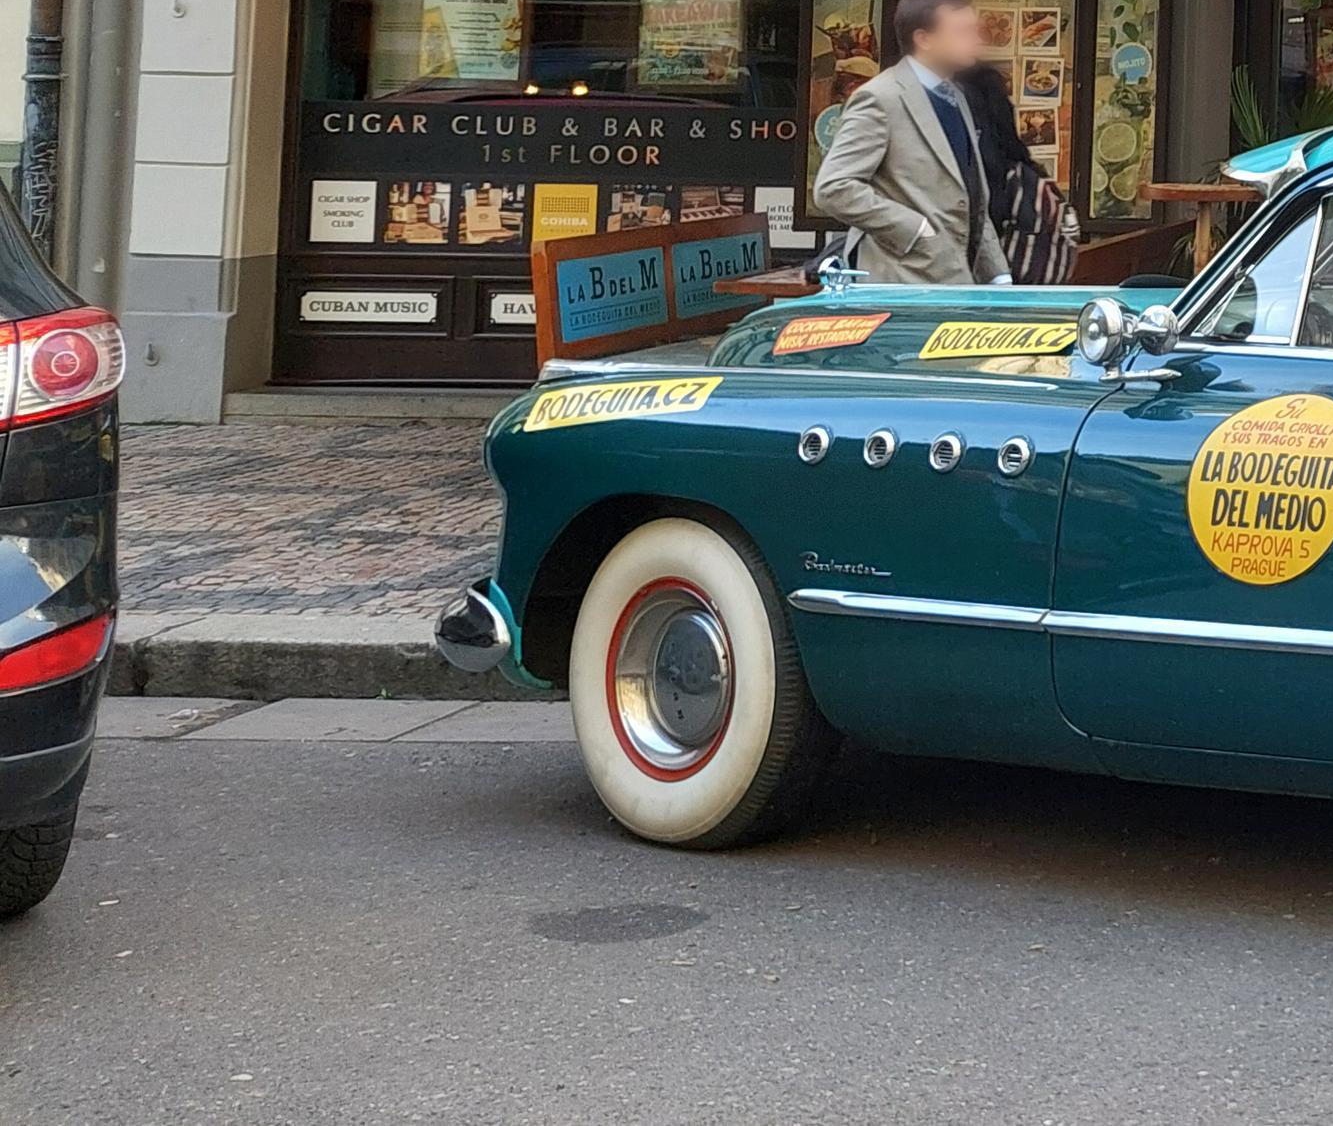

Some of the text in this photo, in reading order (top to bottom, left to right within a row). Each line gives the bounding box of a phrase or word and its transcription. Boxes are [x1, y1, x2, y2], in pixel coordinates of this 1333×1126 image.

[323, 113, 797, 140] CIGAR CLUB & BAR & SHO
[482, 144, 660, 165] 1st FLOOR
[318, 195, 371, 204] CIGAR SHOP
[322, 210, 364, 218] SMOKING
[331, 220, 354, 228] CLUB
[541, 216, 588, 227] COHIBA
[309, 300, 429, 314] CUBAN MUSIC
[502, 302, 537, 314] HAV
[928, 327, 1077, 353] BODEGUITA.CZ
[533, 382, 707, 425] BODEGUITA.CZ
[1275, 398, 1306, 420] Su
[1231, 419, 1286, 433] COMIDA
[1255, 433, 1303, 448] TRAGOS
[1308, 437, 1328, 449] EN
[1200, 450, 1223, 482] LA
[1210, 488, 1326, 532] DEL MEDIO
[1211, 531, 1311, 559] KAPROVA 5
[1230, 557, 1286, 578] PRAGUE
